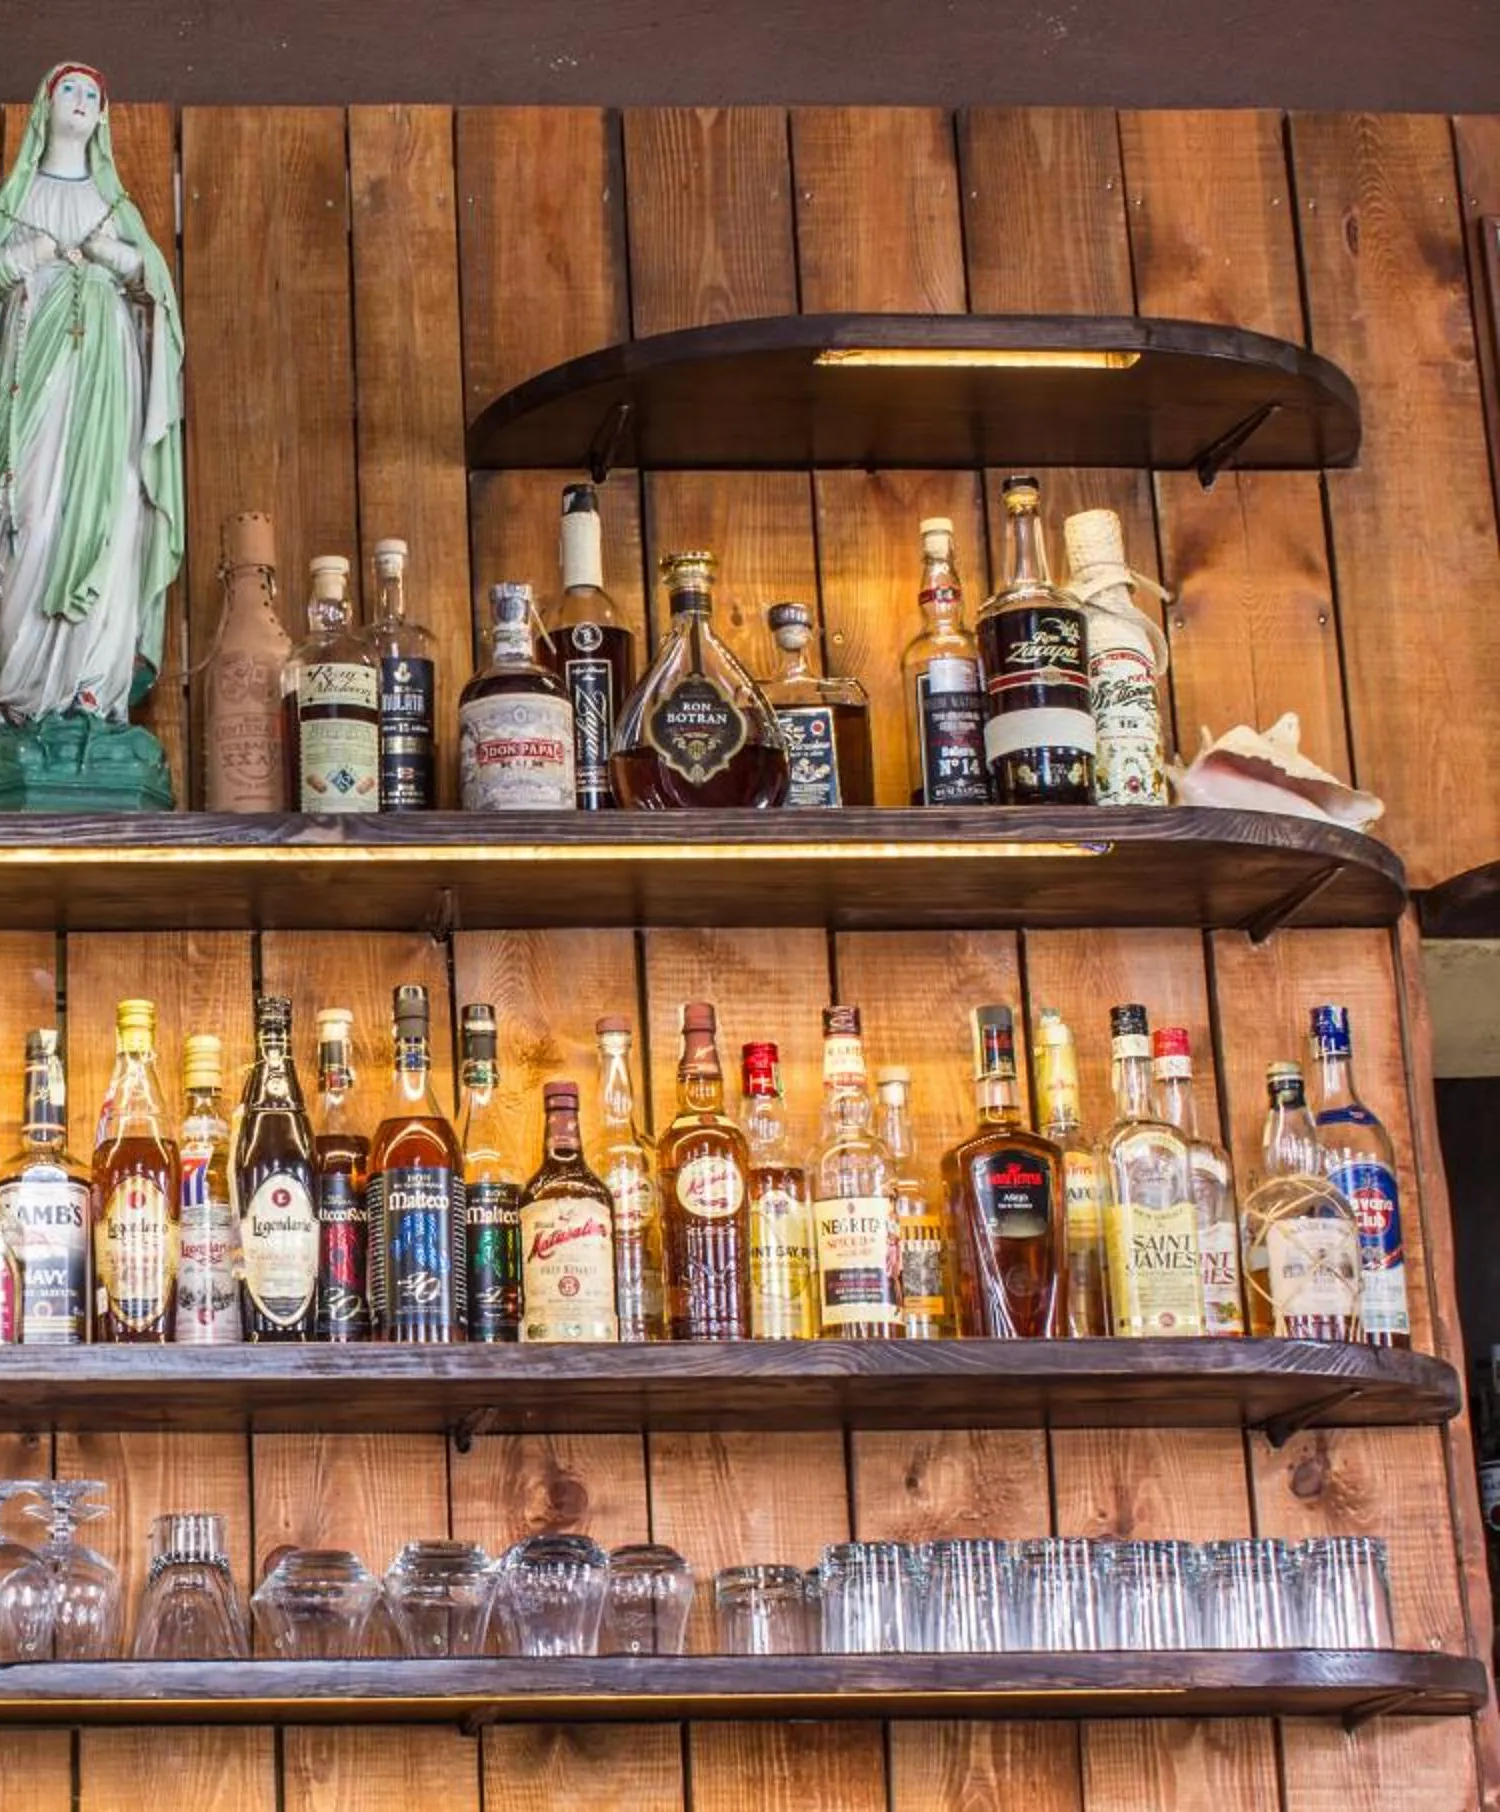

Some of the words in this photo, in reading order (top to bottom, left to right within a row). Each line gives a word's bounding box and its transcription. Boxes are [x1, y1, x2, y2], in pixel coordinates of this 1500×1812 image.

[1005, 642, 1080, 663] Zacapa
[682, 702, 711, 713] RON
[666, 713, 728, 724] BOTRAN
[489, 743, 519, 758] DON
[522, 742, 555, 757] PAPA
[962, 759, 980, 775] 14
[388, 1190, 450, 1211] Malteco
[1351, 1200, 1394, 1211] avana
[17, 1203, 83, 1227] AMB'S
[1355, 1212, 1386, 1228] Club
[821, 1218, 882, 1236] NEGRITA
[1132, 1233, 1191, 1251] SAINT
[1125, 1251, 1198, 1271] JAMES
